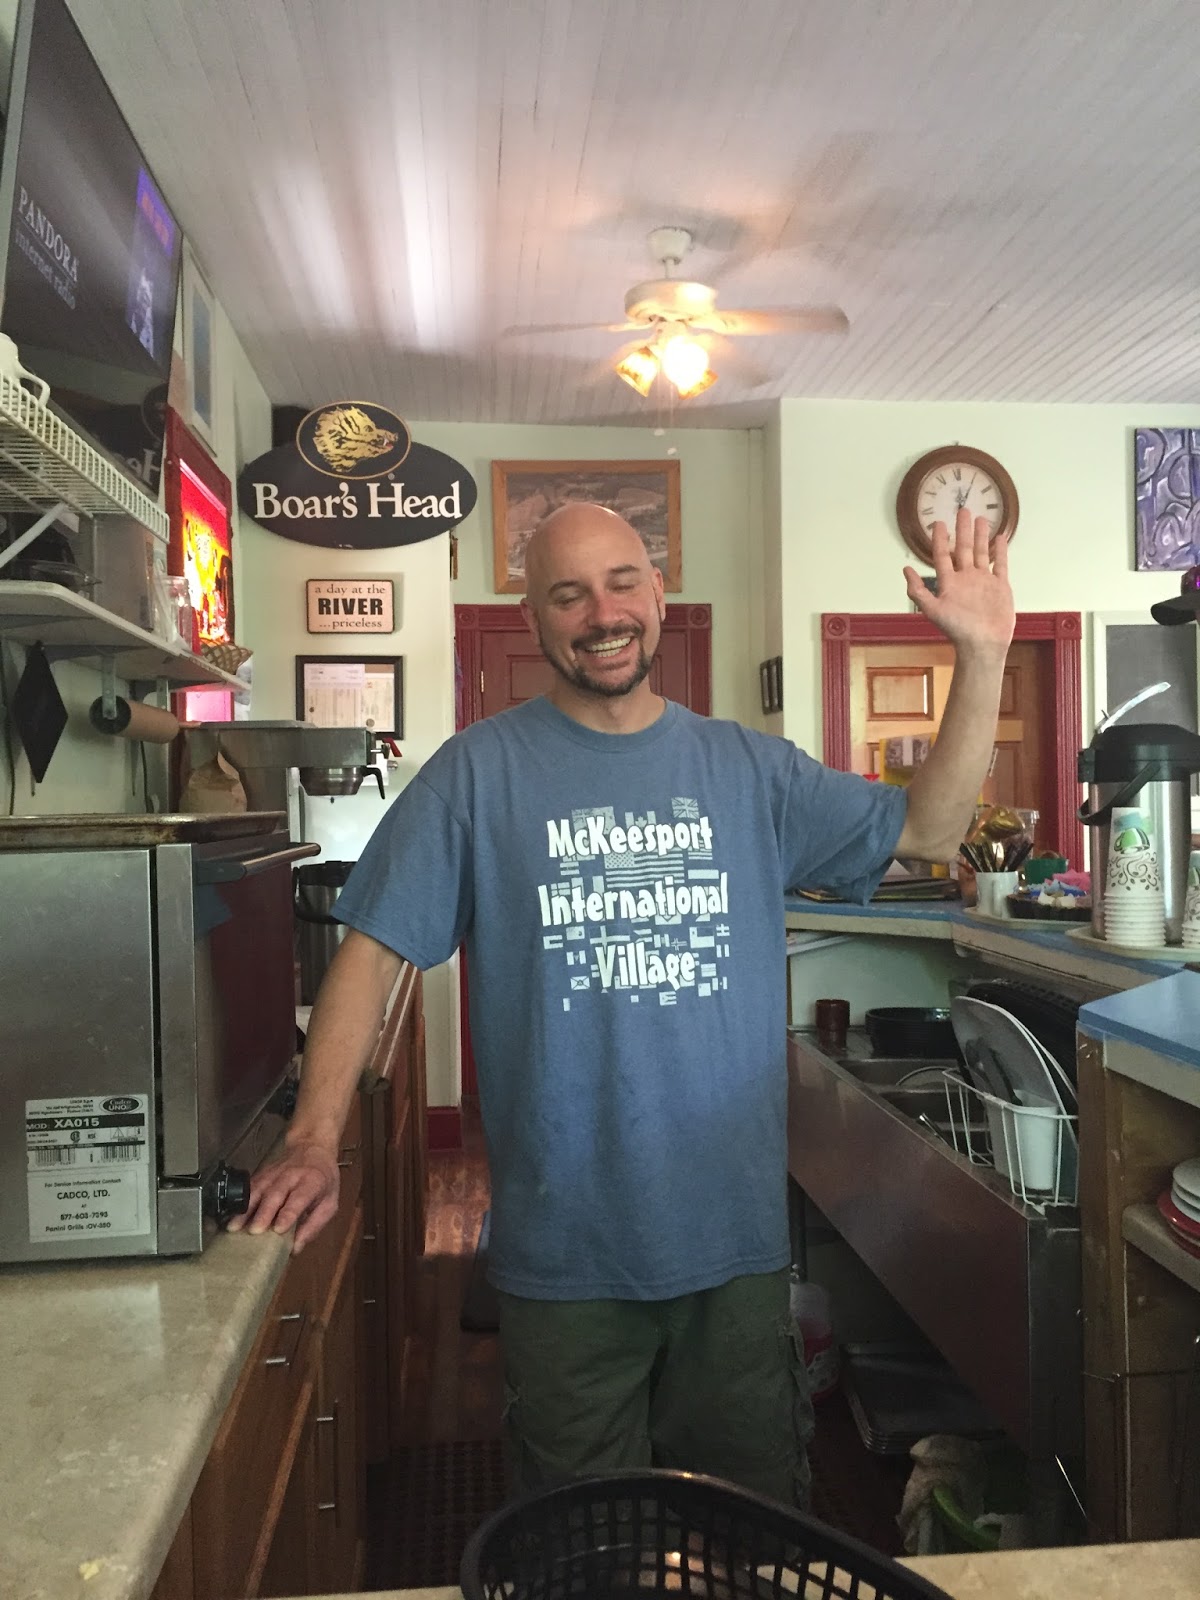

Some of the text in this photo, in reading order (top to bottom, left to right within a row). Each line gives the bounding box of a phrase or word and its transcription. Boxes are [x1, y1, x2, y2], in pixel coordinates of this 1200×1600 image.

[18, 185, 78, 282] PANDORA
[252, 480, 462, 519] Boar's Head
[318, 598, 383, 615] RIVER
[326, 584, 348, 595] day
[352, 586, 362, 594] at
[367, 584, 386, 594] the
[546, 815, 714, 858] McKeesport
[537, 871, 730, 927] International
[594, 940, 696, 991] Village
[54, 1117, 100, 1128] XA015
[56, 1189, 111, 1200] CADCO, LTD.
